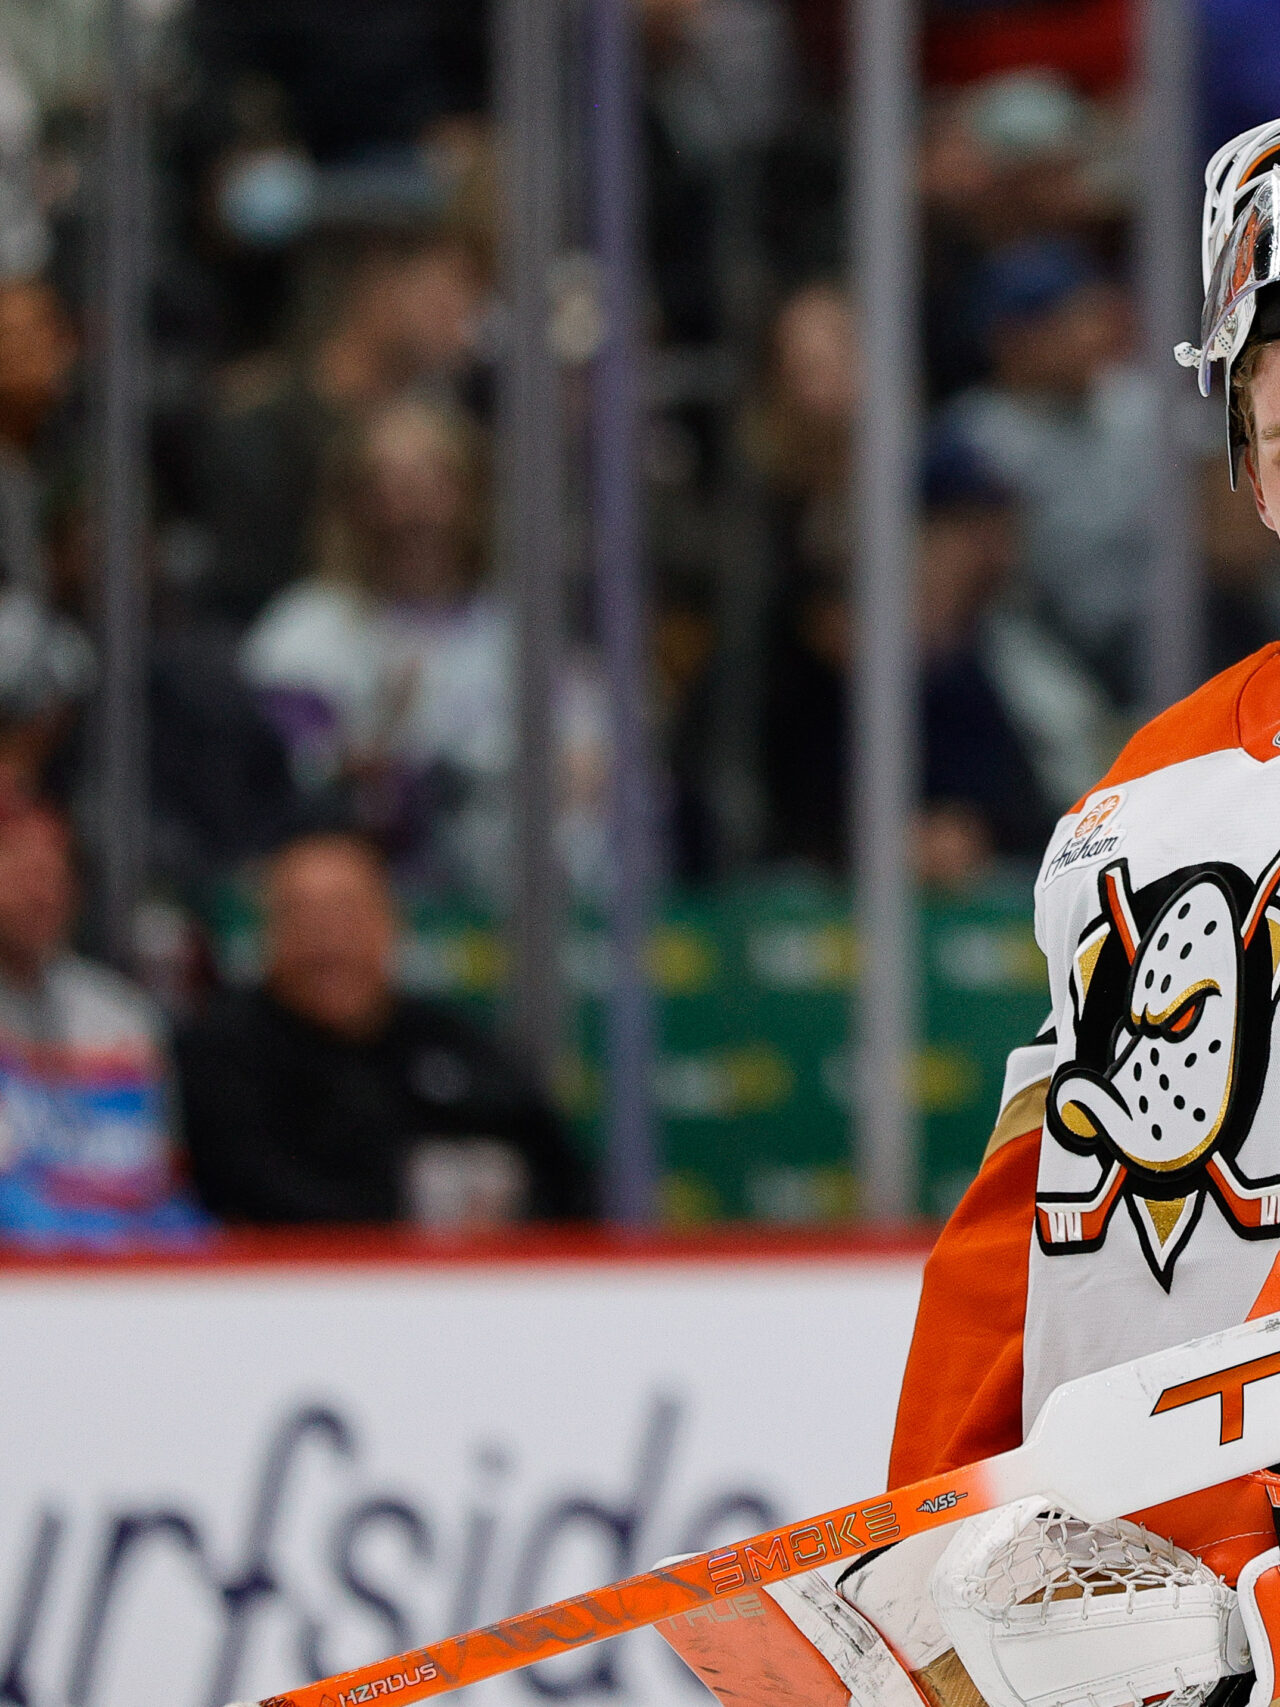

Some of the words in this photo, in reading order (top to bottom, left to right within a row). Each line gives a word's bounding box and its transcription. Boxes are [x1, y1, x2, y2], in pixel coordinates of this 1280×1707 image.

[1043, 824, 1119, 882] Anaheim
[928, 1490, 957, 1513] VSS
[706, 1501, 901, 1595] SMOKE
[664, 1593, 768, 1632] TRUE
[338, 1661, 439, 1707] HZRDUS
